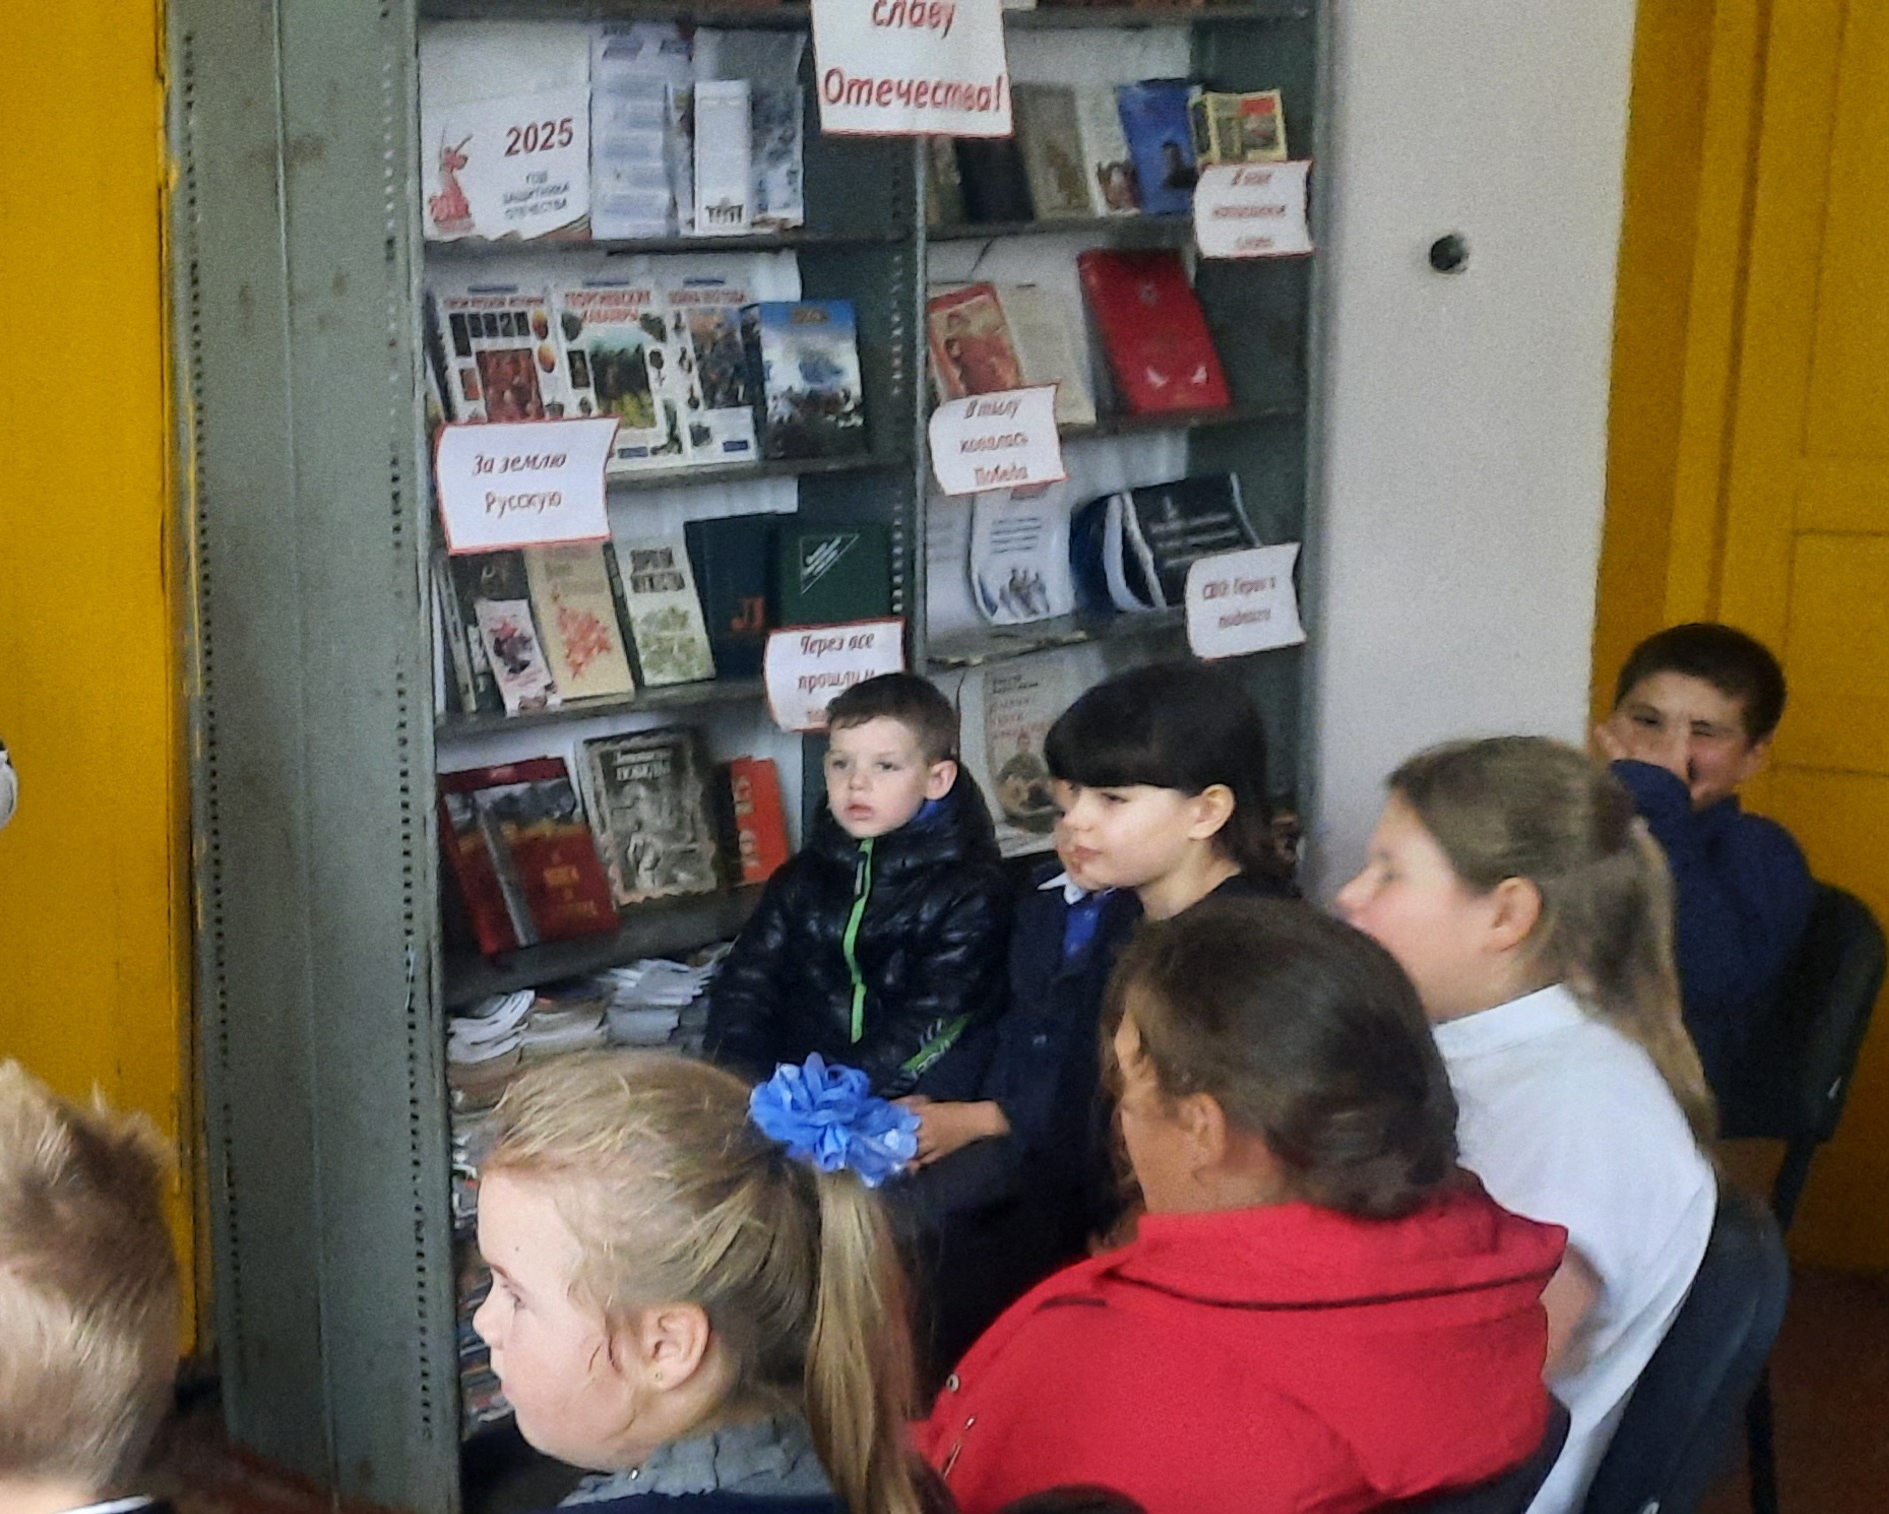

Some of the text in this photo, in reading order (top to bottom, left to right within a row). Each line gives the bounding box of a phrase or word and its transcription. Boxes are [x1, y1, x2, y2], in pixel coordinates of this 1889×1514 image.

[824, 68, 1003, 112] Отечества!
[504, 117, 574, 157] 2025
[472, 453, 567, 476] За землю
[485, 491, 562, 519] Русскую
[800, 632, 875, 658] Через все
